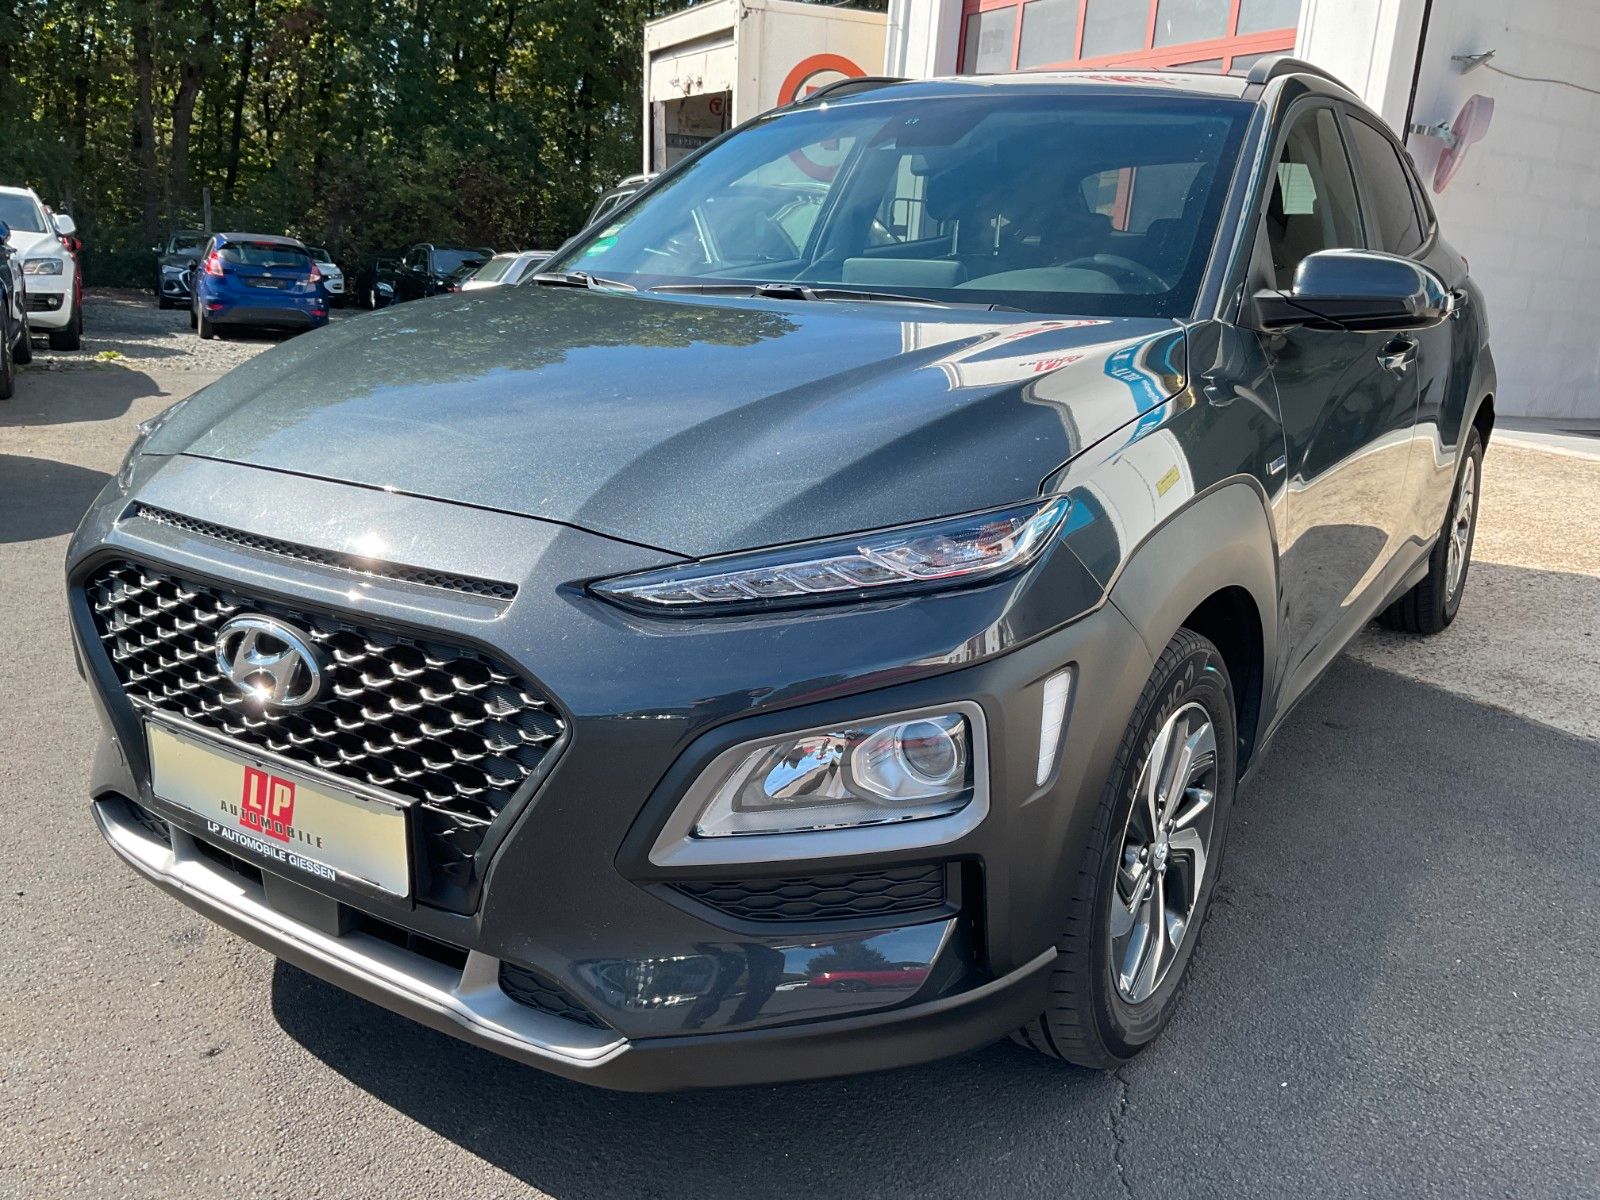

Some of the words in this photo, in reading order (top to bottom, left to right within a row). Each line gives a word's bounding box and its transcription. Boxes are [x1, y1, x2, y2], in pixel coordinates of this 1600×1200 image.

[248, 773, 292, 817] LP
[220, 800, 323, 849] AUTOMOBILE
[207, 820, 220, 833] LP
[221, 828, 286, 862] AUTOMOBILE
[288, 854, 336, 881] GIESSEN
